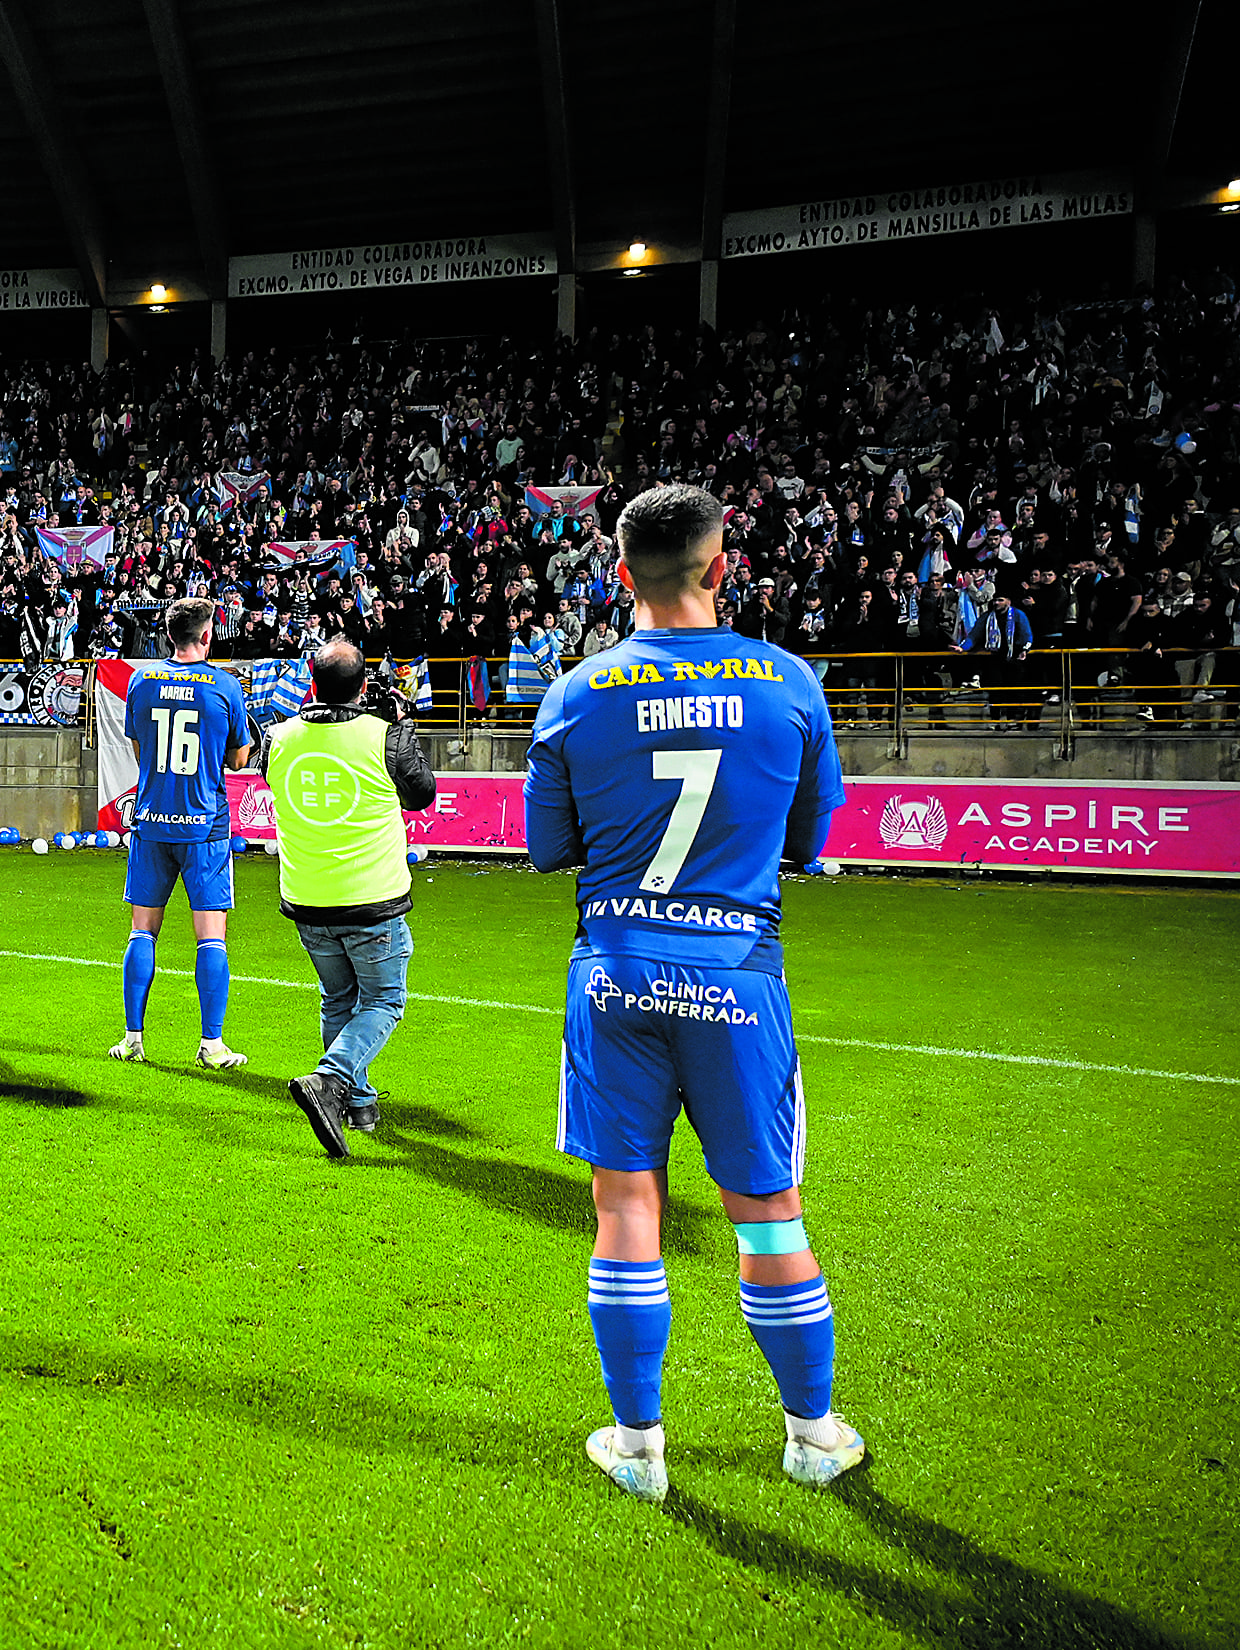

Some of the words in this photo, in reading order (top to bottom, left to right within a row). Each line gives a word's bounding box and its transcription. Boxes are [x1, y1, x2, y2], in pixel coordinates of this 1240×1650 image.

[799, 196, 876, 223] ENTIDAD
[887, 178, 1043, 213] COLABORADORA
[725, 232, 791, 256] EXCMO.
[797, 226, 850, 248] AYTO.
[857, 221, 878, 242] DE
[887, 211, 980, 237] MANSILLA
[989, 205, 1011, 226] DE
[1020, 202, 1054, 223] LAS
[1062, 193, 1128, 217] MULAS
[292, 249, 354, 270] ENTIDAD
[363, 239, 487, 263] COLABORADORA
[238, 276, 294, 295] EXCMO.
[300, 272, 343, 291] AYTO.
[350, 270, 368, 287] DE
[373, 267, 414, 285] VEGA
[420, 265, 438, 281] DE
[445, 255, 546, 279] INFANZONES
[15, 291, 31, 308] LA
[36, 289, 88, 307] VIRGEN
[143, 671, 170, 681] CAJA
[589, 664, 664, 690] CAJA
[159, 685, 195, 702] MARKEL
[637, 695, 743, 733] ERNESTO
[151, 707, 200, 776] 16
[150, 813, 207, 825] VALCARCE
[639, 748, 722, 895] 7
[984, 835, 1159, 855] ACADEMY
[610, 898, 757, 933] VALCARCE
[624, 993, 759, 1026] PONFERRADA
